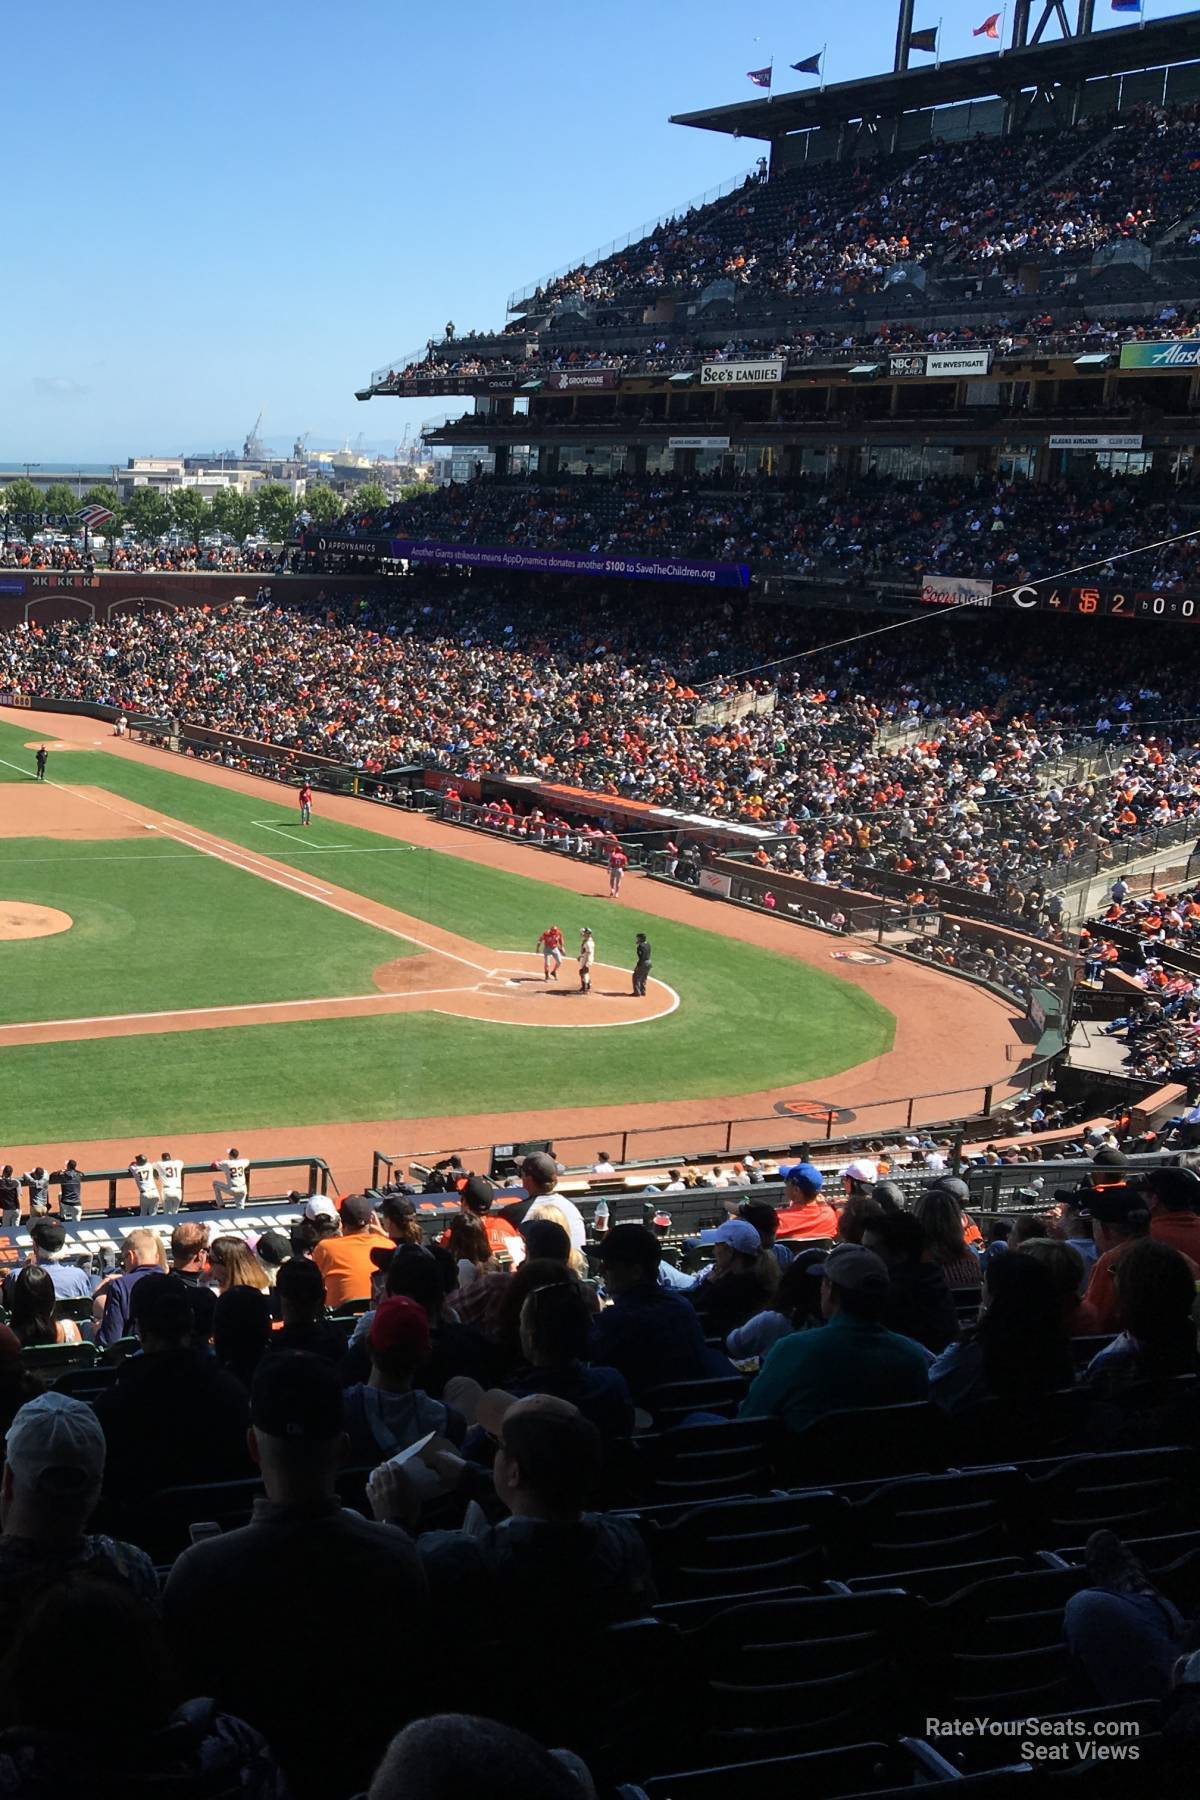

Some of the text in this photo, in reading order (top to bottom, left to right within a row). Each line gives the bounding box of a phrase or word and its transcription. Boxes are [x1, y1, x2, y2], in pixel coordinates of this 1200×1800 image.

[890, 358, 911, 369] NBC
[943, 360, 984, 368] INVESTIGATE
[703, 367, 778, 382] See's CANDIES
[489, 380, 513, 388] ORACLE
[328, 542, 376, 553] APPDYNAMICS
[411, 547, 434, 556] Another
[435, 548, 453, 559] Giants
[455, 550, 480, 560] strikeout
[481, 554, 502, 563] means
[503, 553, 548, 566] AppDynamics
[549, 557, 575, 568] donates
[577, 559, 605, 570] another
[626, 564, 634, 572] to
[636, 563, 716, 581] SaveTheChildren.org
[1049, 590, 1060, 608] 4
[1112, 594, 1125, 613] 2
[1153, 598, 1165, 614] 0
[1182, 600, 1194, 617] 0
[166, 1167, 178, 1178] 31
[230, 1167, 243, 1178] 23
